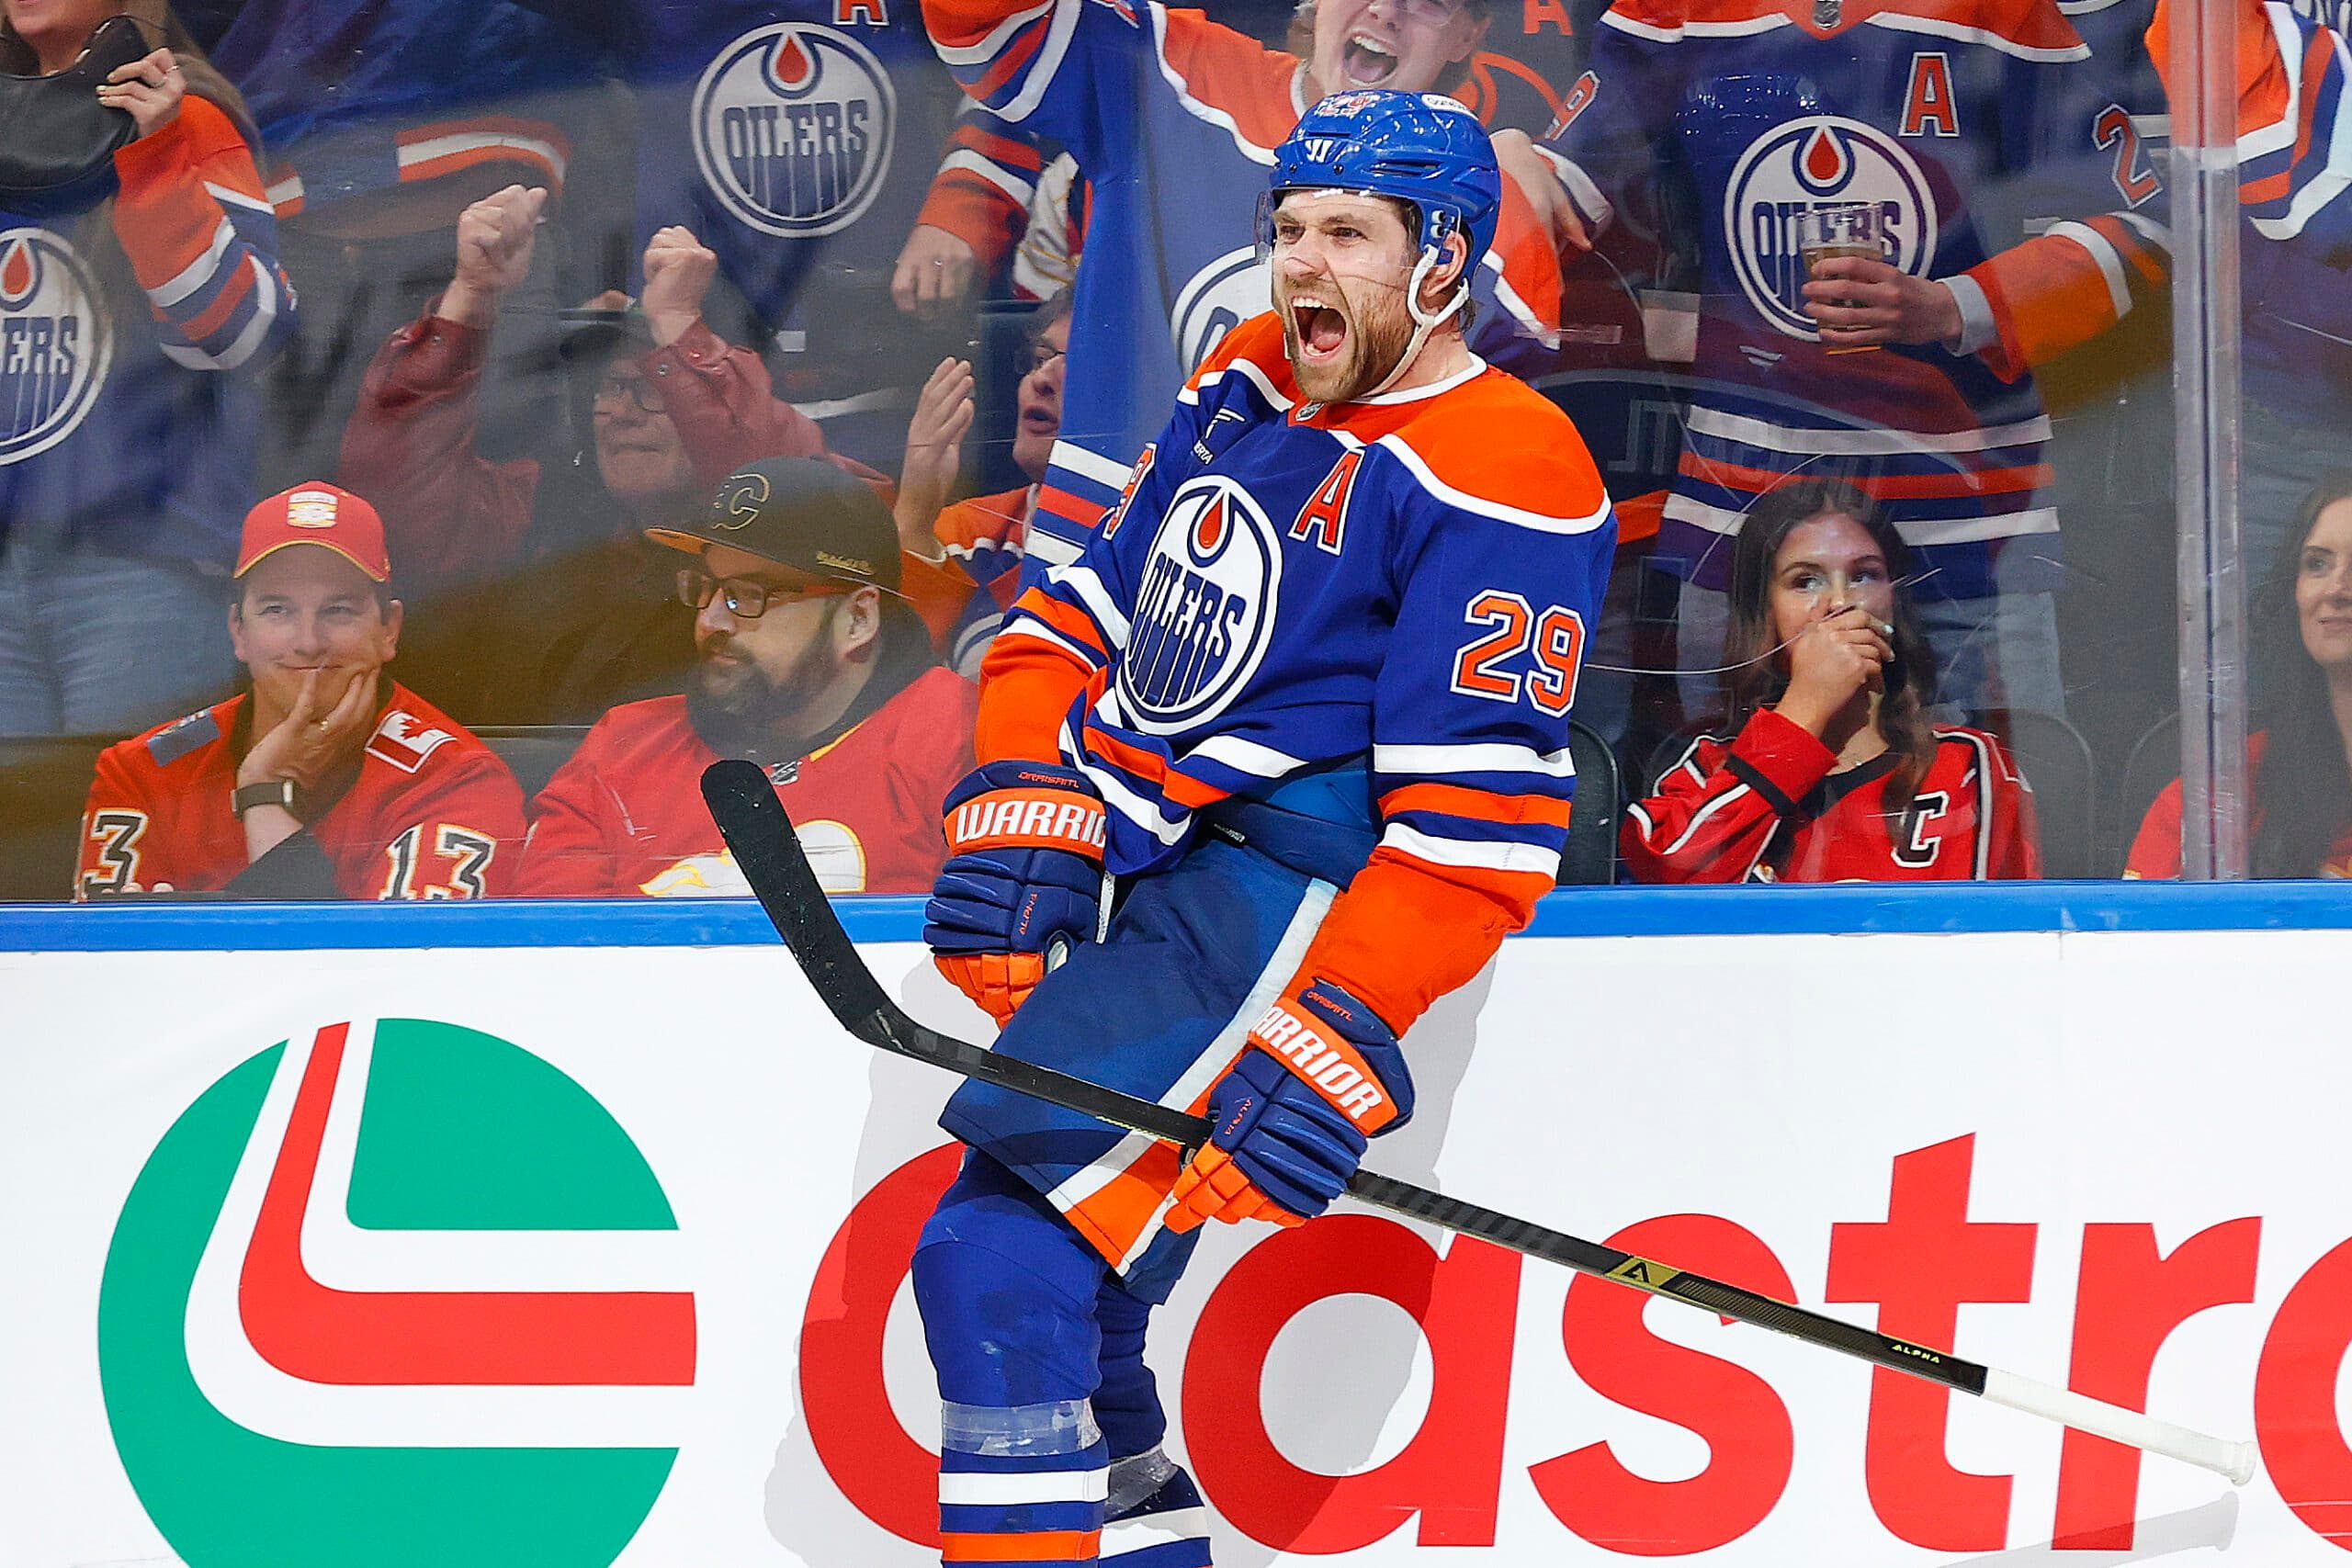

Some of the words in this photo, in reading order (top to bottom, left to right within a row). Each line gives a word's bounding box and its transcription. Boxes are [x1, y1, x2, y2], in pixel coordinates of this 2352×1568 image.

[724, 99, 869, 159] OILERS
[1898, 51, 1960, 137] A
[0, 315, 78, 375] ERS
[1287, 448, 1366, 556] A
[1130, 551, 1248, 660] OILERS
[1450, 588, 1587, 718] 29
[74, 807, 149, 900] 3
[378, 822, 498, 901] 13
[1891, 791, 1950, 868] C
[1252, 1006, 1383, 1120] ARRIOR
[1892, 1344, 1940, 1364] ALPHA
